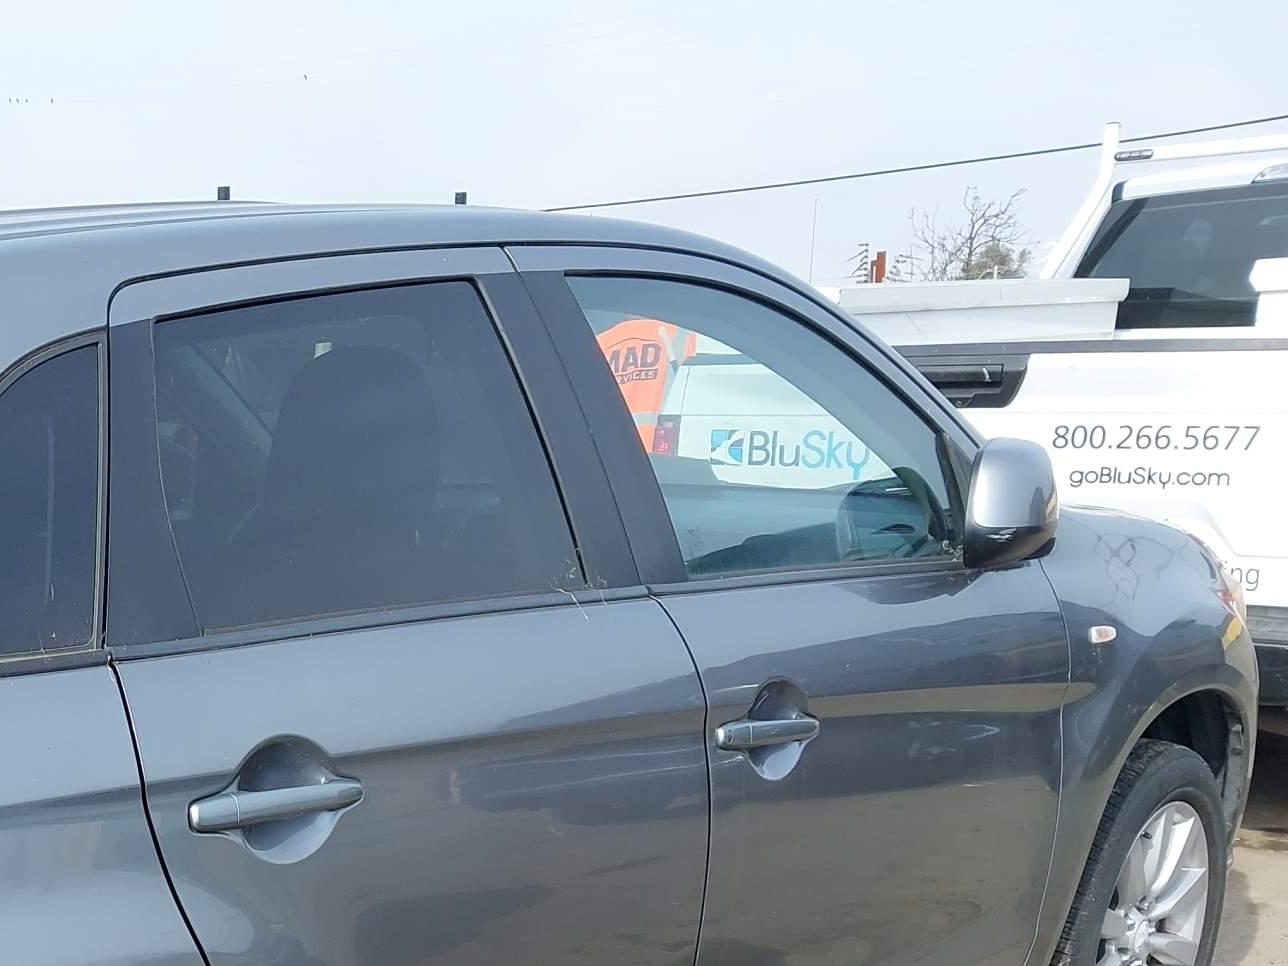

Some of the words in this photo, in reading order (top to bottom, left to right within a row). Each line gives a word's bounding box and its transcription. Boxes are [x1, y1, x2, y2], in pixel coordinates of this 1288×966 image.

[1052, 425, 1261, 450] 800.266.5677
[748, 430, 870, 480] BluSky
[1069, 466, 1231, 489] goBluSky.com
